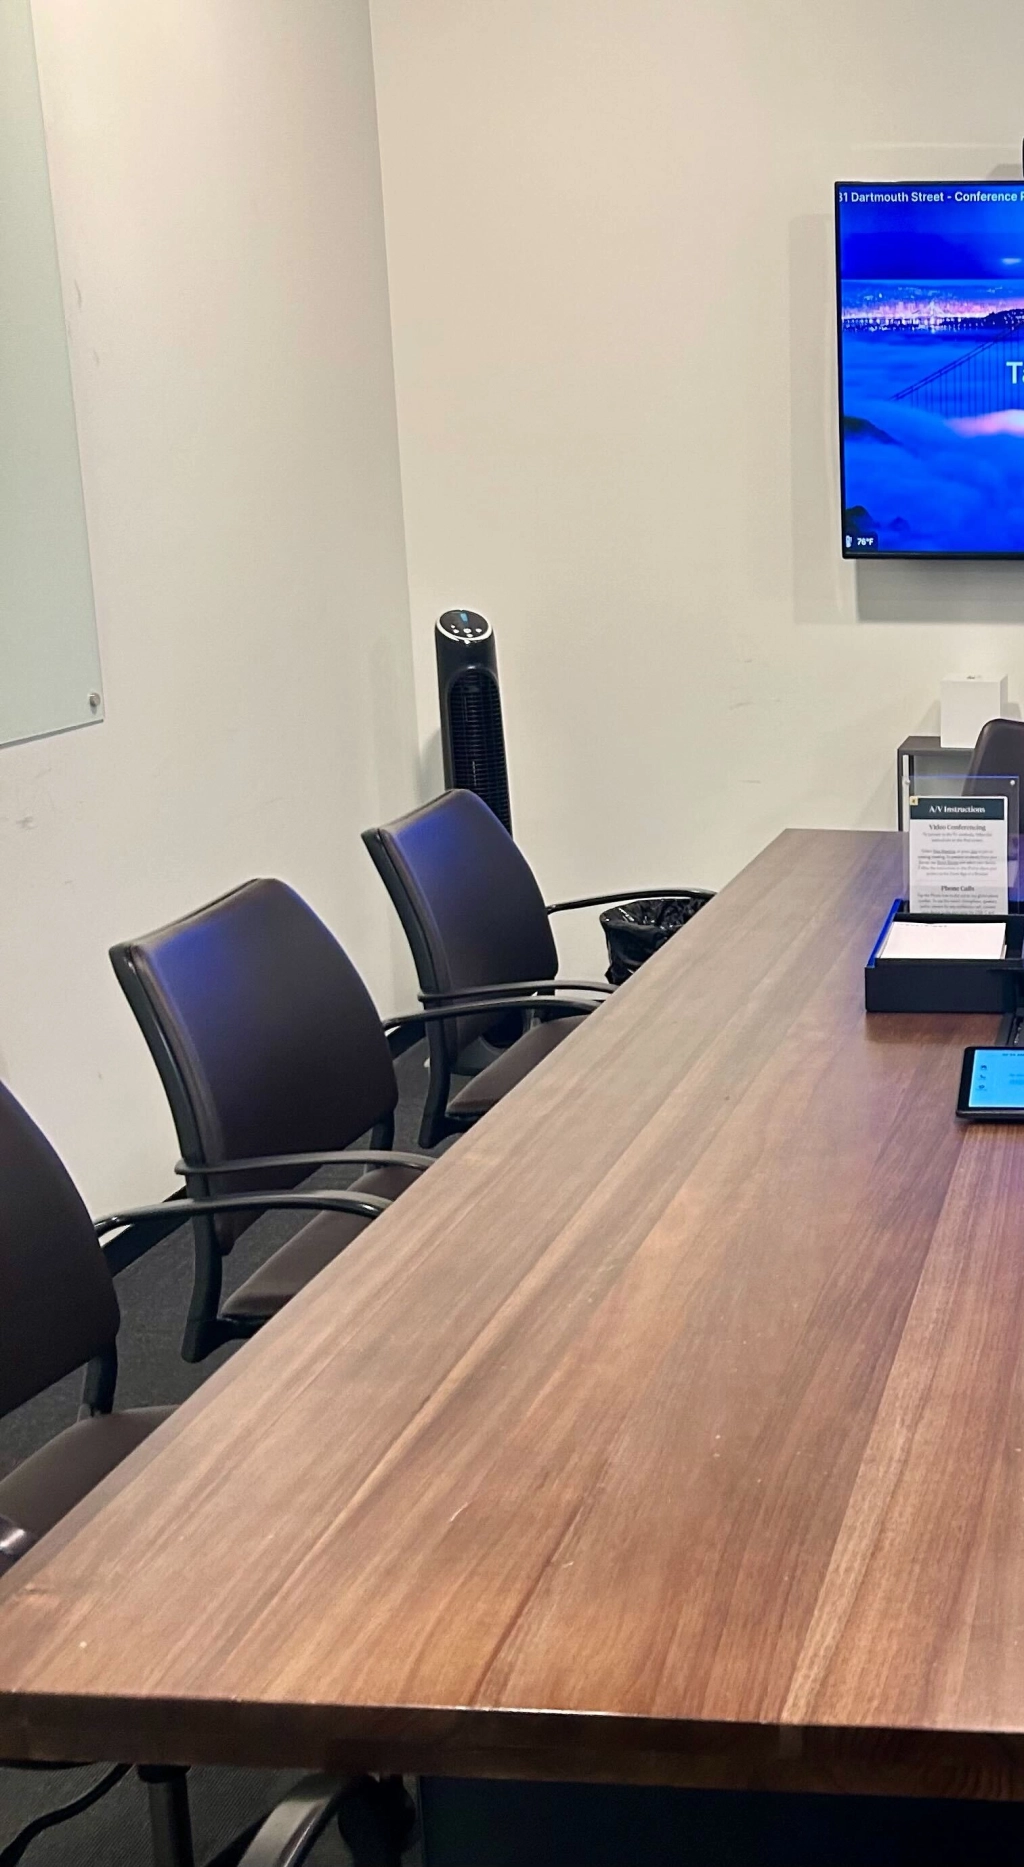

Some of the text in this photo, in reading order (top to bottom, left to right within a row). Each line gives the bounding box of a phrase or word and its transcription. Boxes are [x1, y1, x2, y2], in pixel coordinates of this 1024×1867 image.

[851, 192, 909, 202] Dartmouth
[911, 191, 944, 202] Street
[954, 191, 1018, 202] Conference
[929, 805, 986, 813] A/V Instructions
[947, 824, 986, 832] Conferencing
